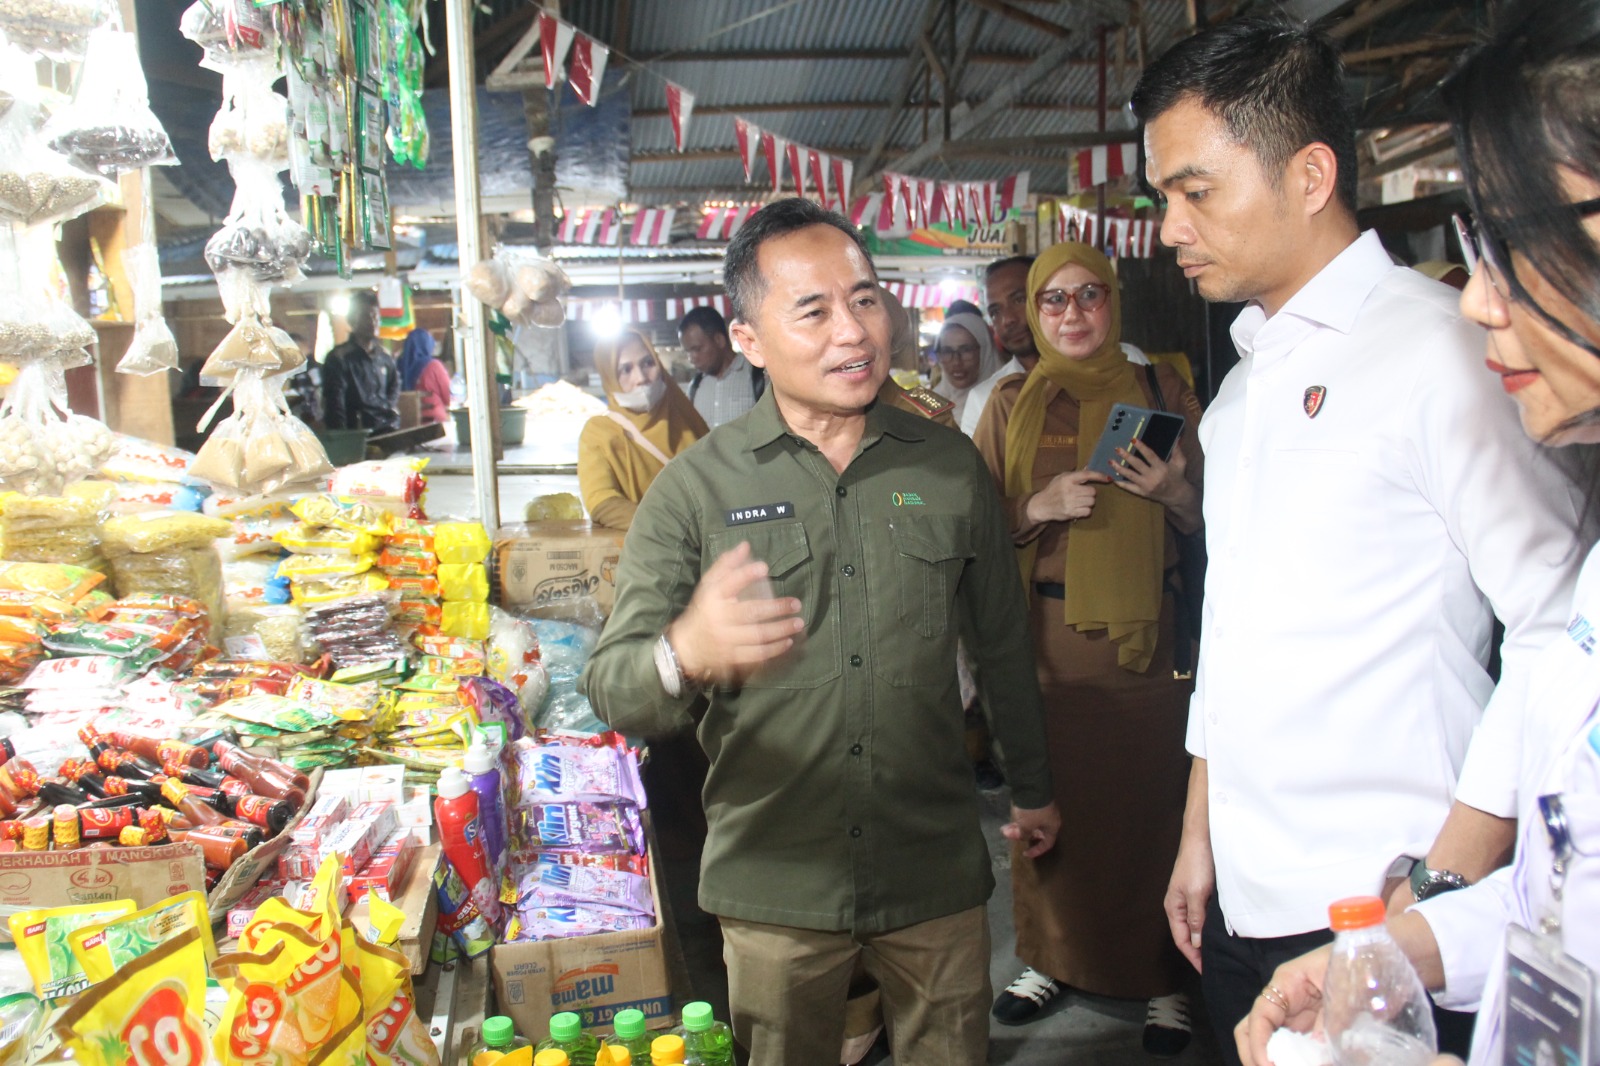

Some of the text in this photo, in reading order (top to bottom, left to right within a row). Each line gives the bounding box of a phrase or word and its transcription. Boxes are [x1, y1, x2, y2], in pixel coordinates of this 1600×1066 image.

[731, 505, 786, 521] INDRA W
[537, 804, 571, 846] Klin
[0, 853, 81, 868] ERHADIAH
[26, 923, 45, 935] BARU
[551, 974, 614, 1006] mama
[598, 1008, 614, 1022] GT
